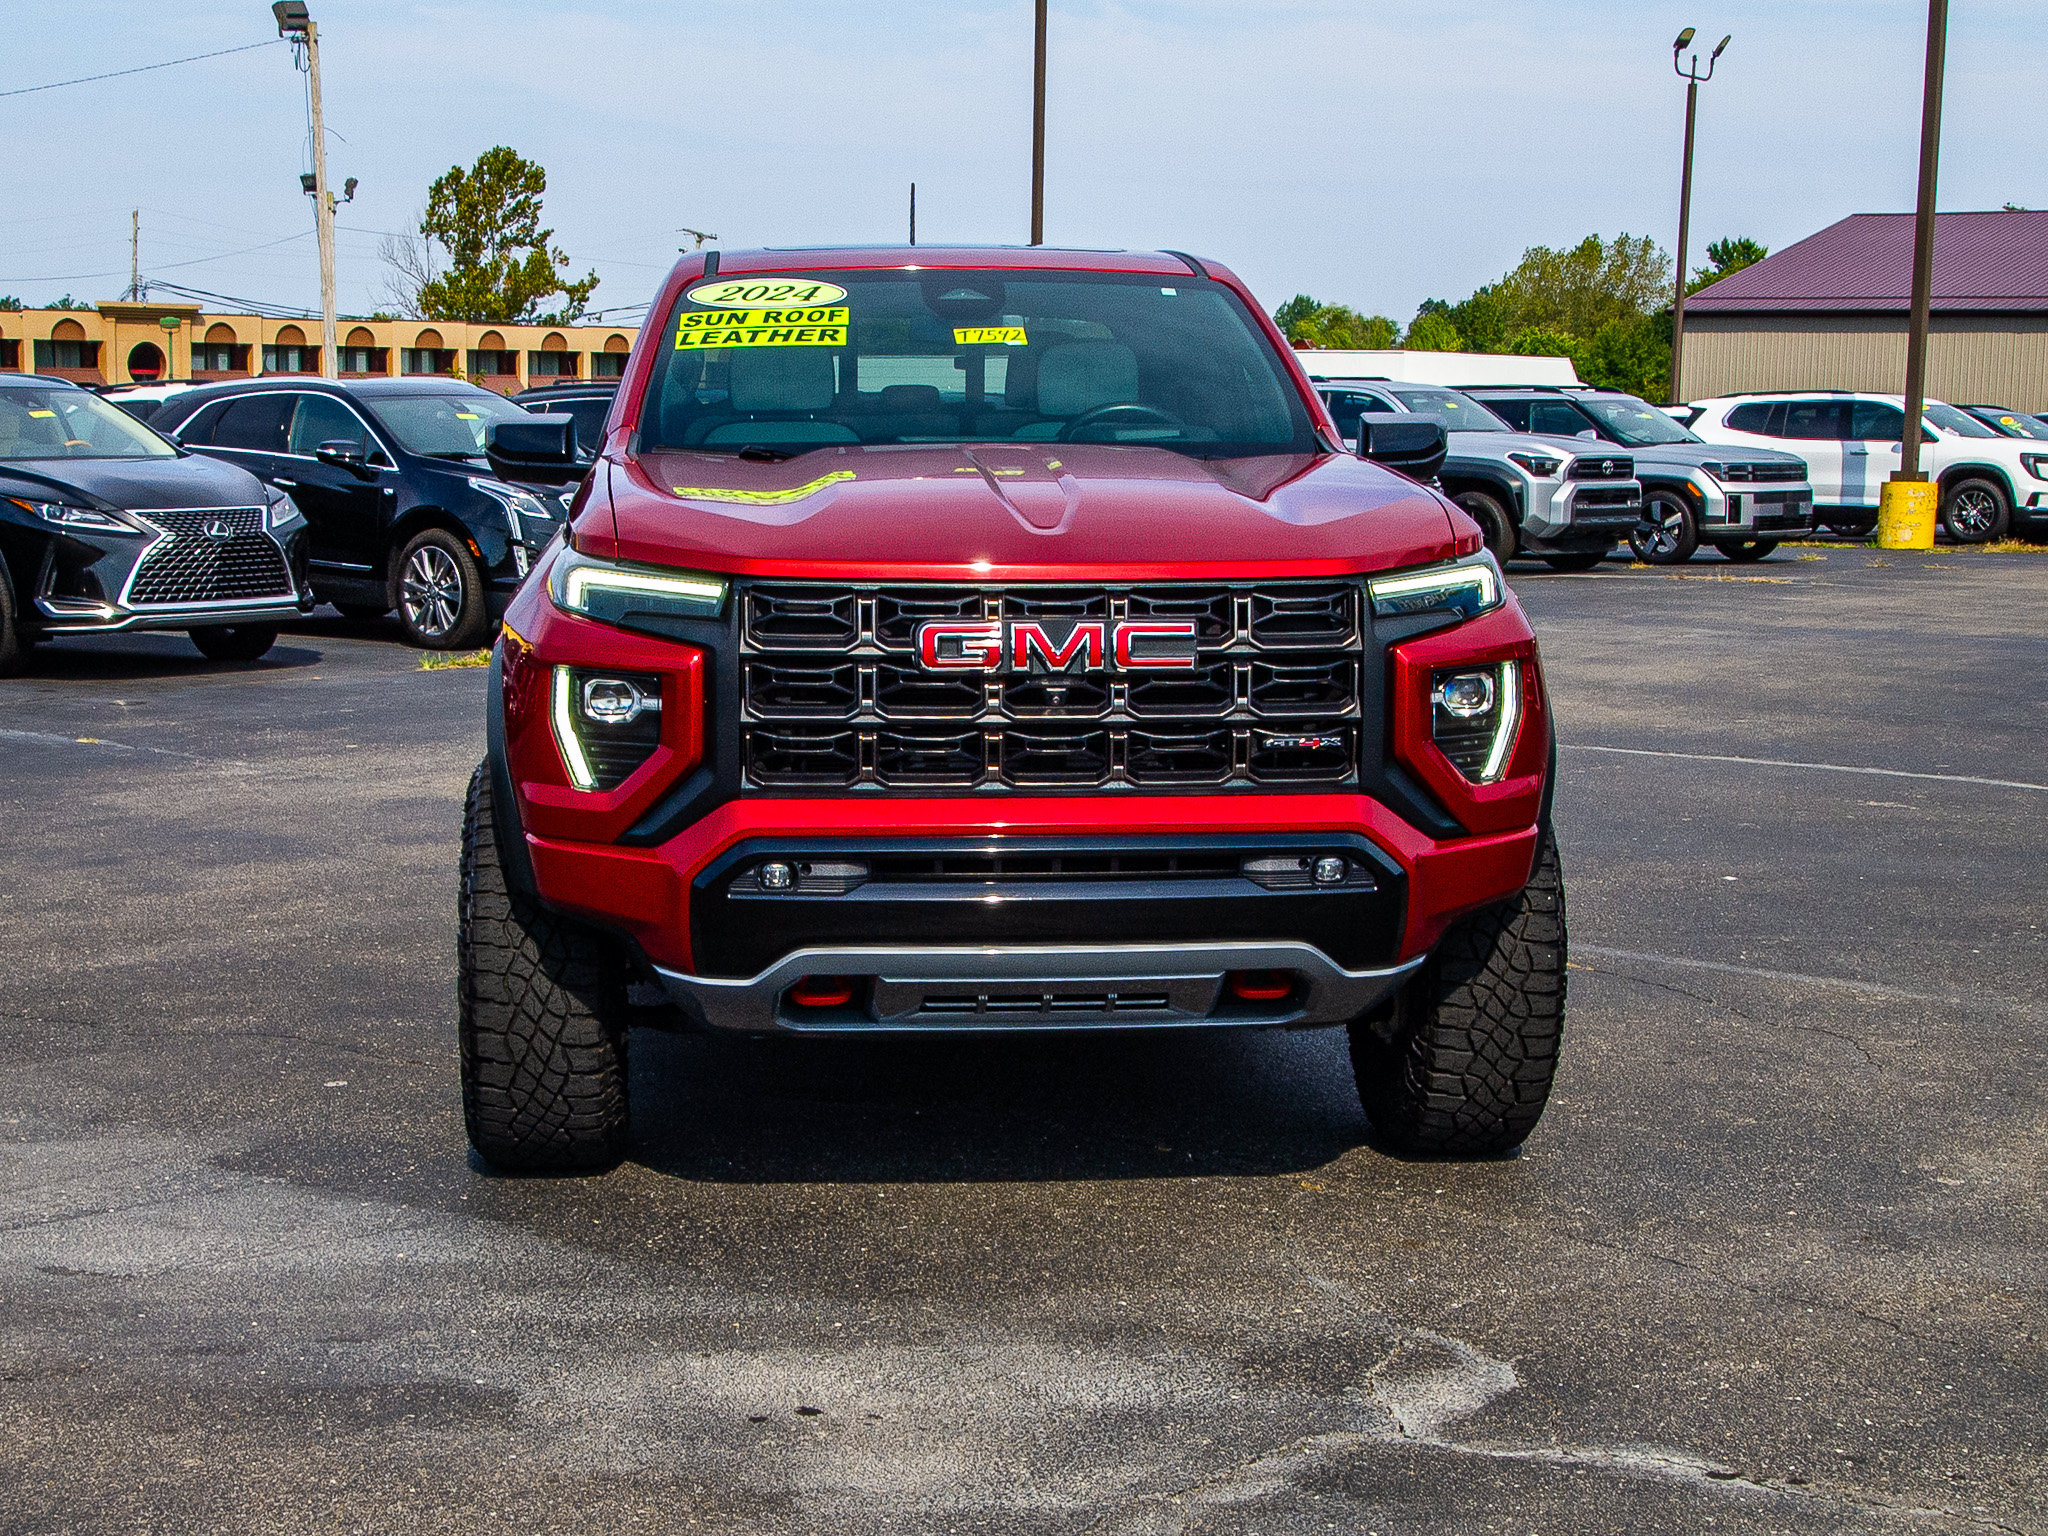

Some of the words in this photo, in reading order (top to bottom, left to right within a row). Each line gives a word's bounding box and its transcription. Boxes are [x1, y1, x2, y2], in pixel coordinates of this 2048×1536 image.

[713, 285, 822, 302] 2024
[683, 312, 750, 328] SUN
[762, 309, 845, 324] ROOF
[679, 328, 840, 346] LEATHER
[918, 620, 1196, 672] GMC
